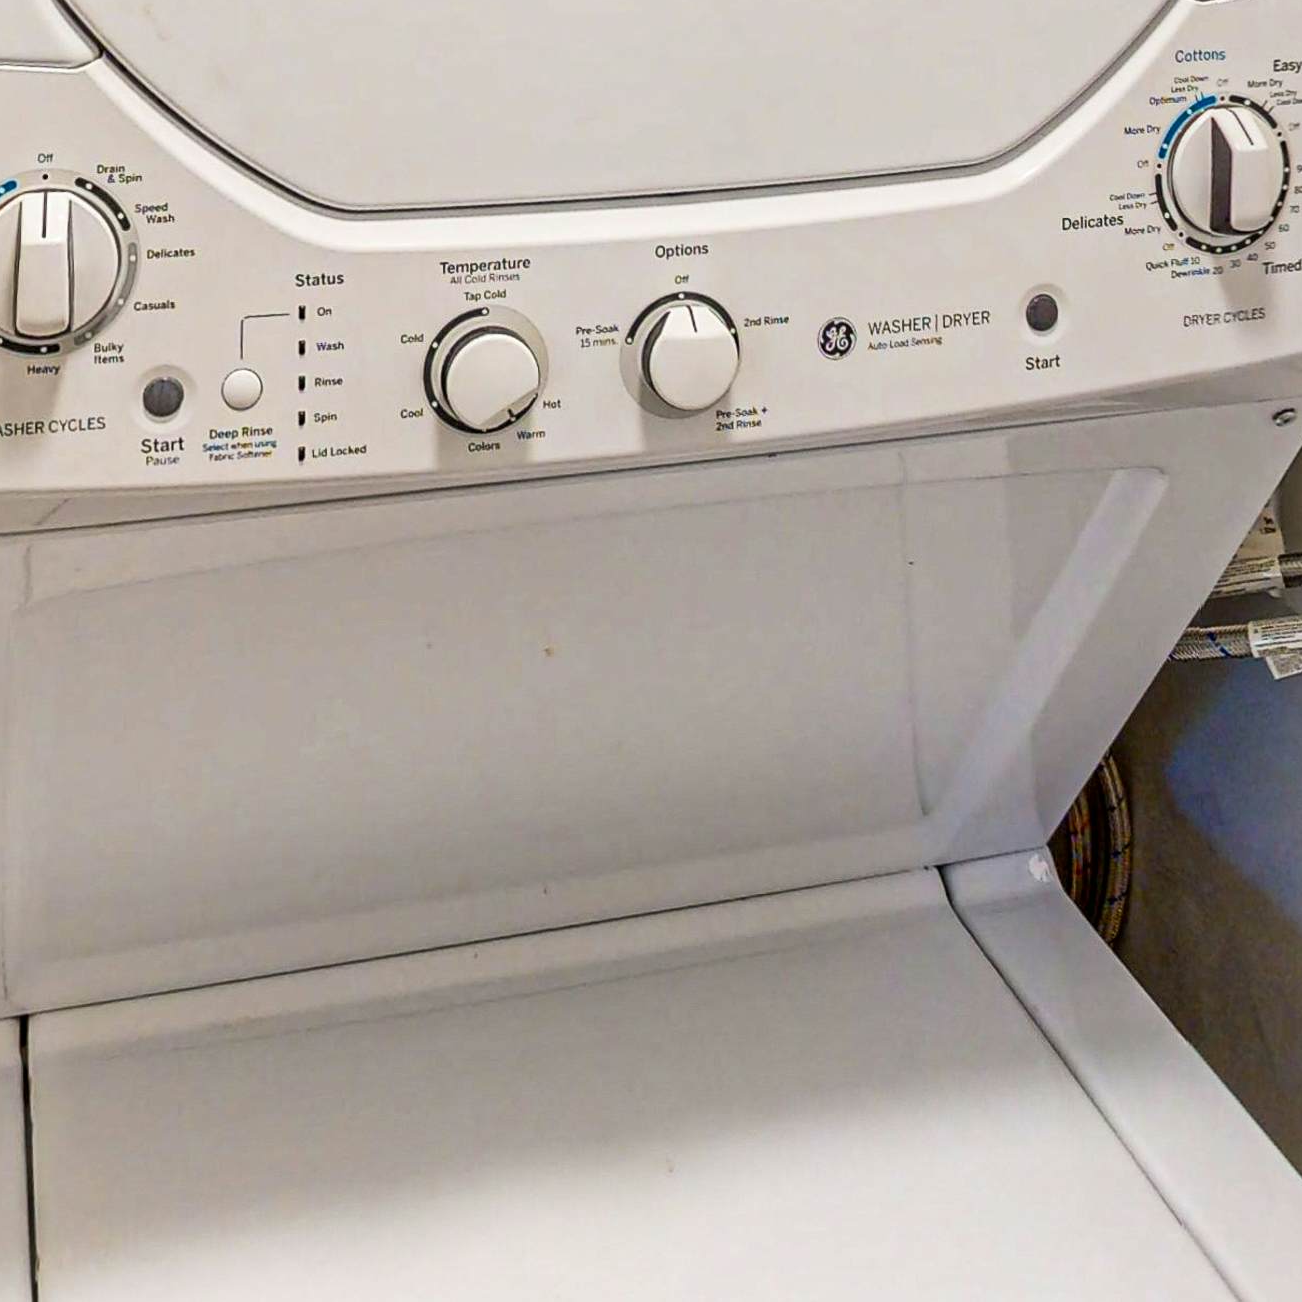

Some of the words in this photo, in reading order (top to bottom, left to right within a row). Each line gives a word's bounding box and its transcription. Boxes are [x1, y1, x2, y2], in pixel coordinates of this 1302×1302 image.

[1175, 50, 1226, 63] Cottons
[1273, 59, 1302, 73] Easy
[1186, 85, 1199, 93] Dry
[1247, 80, 1268, 88] More
[1269, 78, 1284, 88] Dry
[1149, 96, 1187, 106] Optimum
[1124, 126, 1145, 135] More
[1146, 124, 1161, 135] Dry
[37, 154, 54, 164] Off
[97, 164, 126, 174] Drain
[107, 174, 116, 184] &
[118, 173, 143, 184] Spin
[134, 202, 169, 215] Speed
[1135, 202, 1147, 210] Dry
[146, 213, 175, 224] Wash
[1062, 214, 1124, 231] Delicates
[1124, 227, 1145, 235] More
[1147, 225, 1161, 234] Dry
[146, 248, 196, 260] Delicates
[655, 243, 709, 260] Options
[439, 257, 531, 275] Temperature
[1146, 260, 1169, 272] Quick
[1170, 258, 1189, 267] Fluff
[1191, 257, 1201, 266] 10
[1230, 259, 1242, 268] 30
[1263, 260, 1302, 275] Timed
[1171, 267, 1210, 279] Dewrinkle
[1213, 266, 1224, 275] 20
[295, 273, 345, 287] Status
[450, 275, 463, 285] All
[464, 274, 487, 284] Cold
[488, 273, 521, 282] Rinses
[674, 274, 689, 285] Off
[464, 291, 482, 302] Tap
[483, 289, 507, 300] Cold
[133, 300, 176, 312] Casuals
[317, 307, 332, 317] On
[743, 317, 762, 328] 2nd
[763, 315, 790, 326] Rinse
[868, 315, 931, 336] WASHER
[942, 310, 991, 329] DRYER
[1183, 313, 1221, 328] DRYER
[1223, 307, 1266, 324] CYCLES
[575, 325, 620, 337] Pre-Soak
[400, 333, 424, 345] Cold
[580, 338, 591, 348] 15
[867, 340, 888, 351] Auto
[889, 338, 909, 349] Load
[911, 335, 943, 347] Sensing
[93, 343, 124, 354] Bulky
[316, 341, 345, 351] Wash
[93, 354, 125, 365] Items
[1025, 354, 1061, 371] Start
[27, 364, 61, 376] Heavy
[314, 377, 344, 387] Rinse
[543, 399, 561, 409] Hot
[313, 412, 338, 424] Spin
[400, 408, 424, 419] Cool
[716, 407, 758, 420] Pre-Soak
[48, 416, 107, 434] CYCLES
[716, 421, 734, 431] 2nd
[736, 418, 762, 430] Rinse
[209, 428, 239, 441] Deep
[241, 426, 273, 437] Rinse
[516, 430, 546, 440] Warm
[140, 436, 186, 454] Start
[202, 442, 229, 452] Select
[230, 441, 253, 450] when
[254, 439, 278, 450] using
[468, 442, 501, 453] Colors
[208, 452, 234, 462] Fabric
[236, 449, 273, 460] Softener
[312, 447, 328, 459] Lid
[330, 445, 367, 457] Locked
[146, 455, 180, 467] Pause
